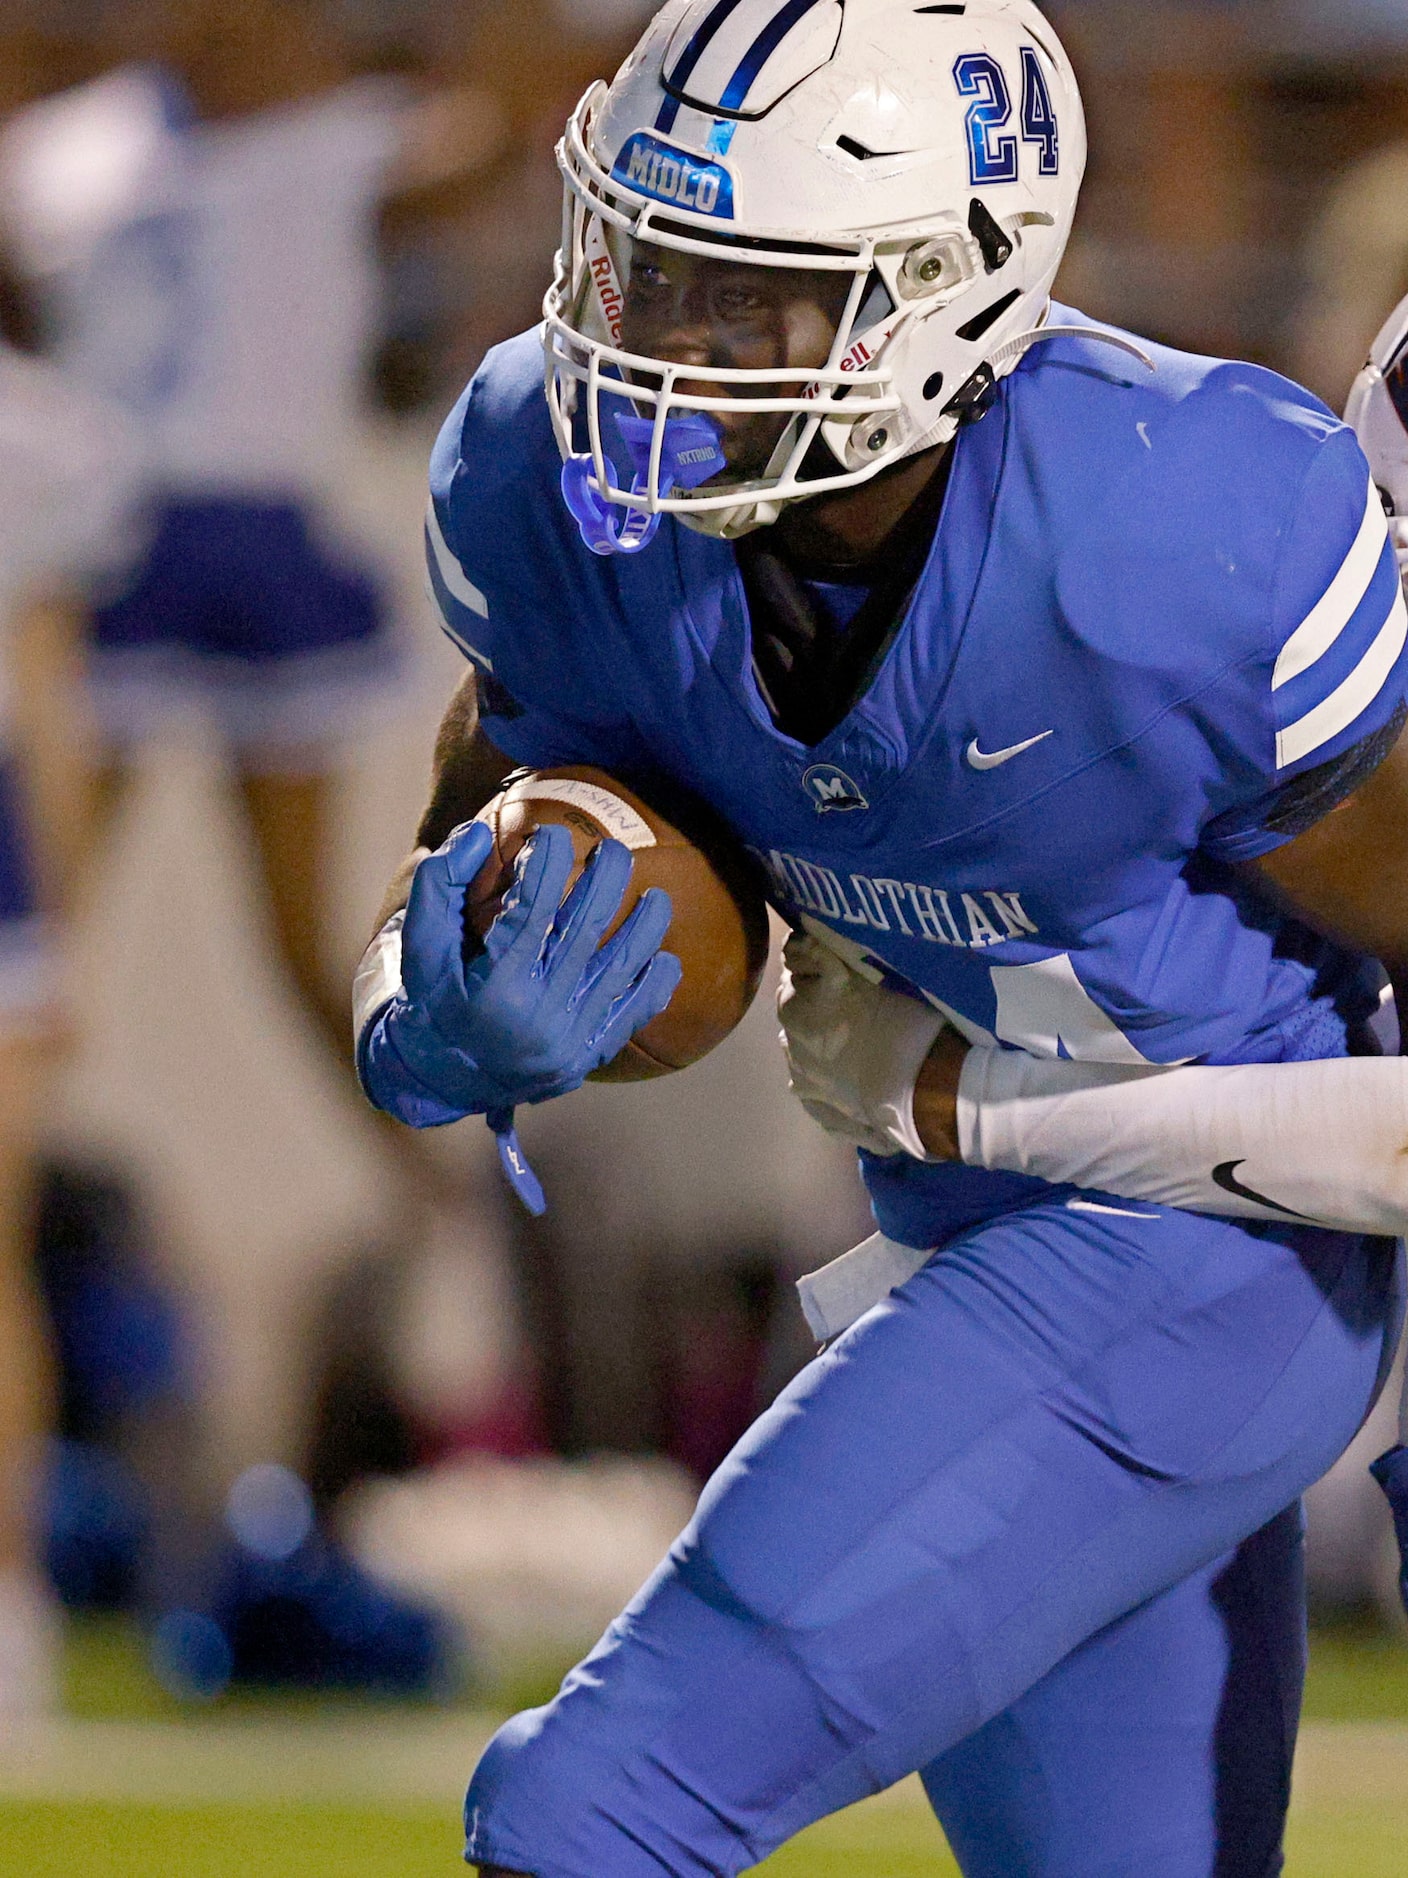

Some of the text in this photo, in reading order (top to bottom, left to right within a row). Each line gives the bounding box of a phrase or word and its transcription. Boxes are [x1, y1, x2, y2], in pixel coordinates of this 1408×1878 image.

[951, 46, 1060, 186] 24
[626, 141, 721, 213] MIDLO
[591, 255, 623, 350] Ridde
[747, 844, 1039, 948] MIDLOTHIAN
